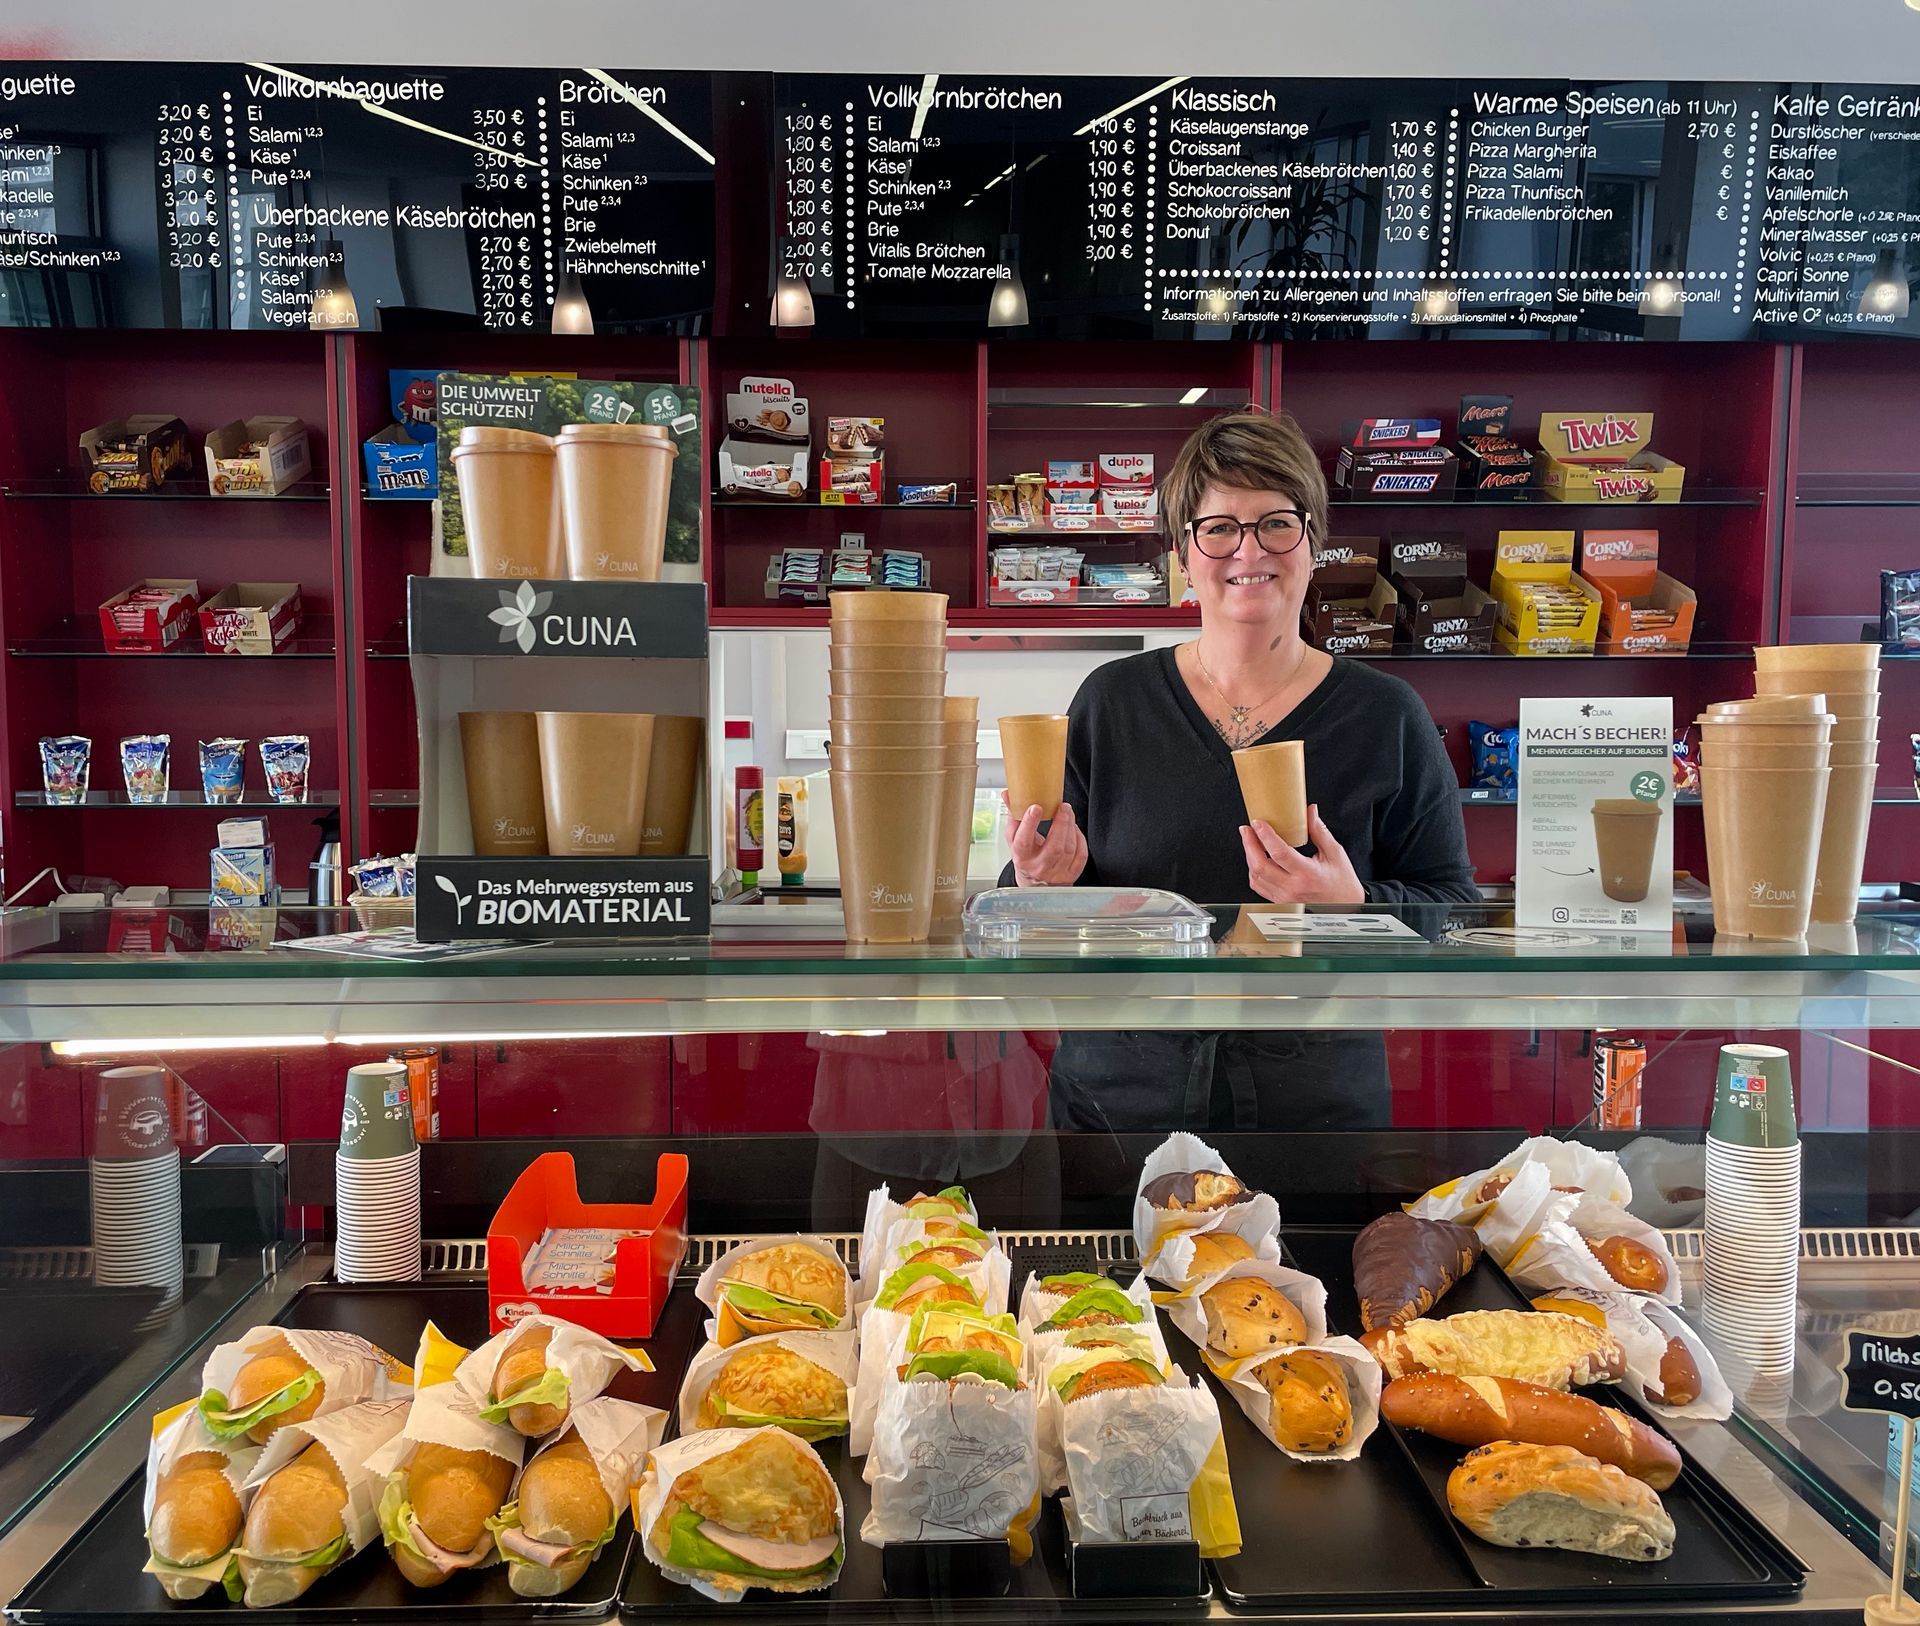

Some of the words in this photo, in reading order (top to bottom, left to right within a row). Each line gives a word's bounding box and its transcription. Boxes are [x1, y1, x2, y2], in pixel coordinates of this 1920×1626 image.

[0, 72, 75, 100] guette
[245, 74, 444, 104] Vollkornbaguette
[560, 80, 666, 103] Brötchen
[868, 85, 1062, 110] Vollkornbrötchen
[1172, 89, 1276, 112] Klassisch
[1473, 91, 1558, 113] Warme
[1565, 91, 1654, 119] Speisen
[1657, 101, 1681, 118] (ab
[1687, 102, 1700, 115] 11
[1704, 101, 1737, 118] Uhr)
[1773, 94, 1829, 116] Kalte
[158, 105, 191, 121] 3,20
[248, 106, 262, 121] Ei
[473, 110, 505, 127] 3,50
[561, 112, 575, 126] Ei
[868, 116, 881, 131] Ei
[1171, 118, 1308, 138] Käselaugenstange
[1390, 122, 1418, 138] 1,70
[1470, 121, 1531, 138] Chicken
[1536, 123, 1589, 141] Burger
[1688, 123, 1718, 139] 2,70
[1771, 124, 1865, 139] Durstlöscher
[1089, 140, 1117, 156] 1,90
[1169, 140, 1241, 156] Croissant
[1392, 143, 1417, 158] 1,40
[1469, 142, 1508, 158] Pizza
[1514, 144, 1597, 161] Margherita
[1769, 144, 1837, 159] Eiskaffee
[1168, 160, 1277, 178] Überbackenes
[1282, 162, 1388, 179] Käsebrötchen
[1389, 164, 1416, 179] 1,60
[1468, 163, 1507, 179] Pizza
[1513, 164, 1563, 179] Salami
[1767, 166, 1814, 180] Kakao
[1168, 182, 1292, 199] Schokocroissant
[1466, 185, 1505, 200] Pizza
[1510, 184, 1583, 200] Thunfisch
[1766, 185, 1848, 201] Vanillemilch
[255, 198, 389, 226] Überbackene
[397, 206, 535, 229] Käsebrötchen
[1167, 204, 1289, 219] Schokobrötchen
[1386, 206, 1413, 222] 1,20
[1465, 205, 1613, 222] Frikadellenbrötchen
[1763, 207, 1853, 224] Apfelschorle
[565, 217, 596, 232] Brie
[868, 222, 899, 237] Brie
[1167, 224, 1210, 240] Donut
[1760, 227, 1868, 241] Mineralwasser
[480, 237, 512, 253] 2,70
[565, 238, 656, 254] Zwiebelmett
[868, 243, 911, 258] Vitalis
[916, 243, 985, 258] Brötchen
[1760, 247, 1802, 261] Volvic
[1847, 253, 1876, 263] Pfand)
[785, 263, 815, 280] 2,70
[868, 264, 926, 279] Tomate
[932, 264, 1011, 280] Mozzarella
[1757, 267, 1797, 285] Capri
[1803, 267, 1849, 282] Sonne
[1163, 288, 1259, 302] Informationen
[1263, 291, 1279, 301] zu
[1284, 288, 1358, 305] Allergenen
[1362, 289, 1388, 302] und
[1393, 289, 1484, 302] Inhaltsstoffen
[1489, 289, 1551, 305] erfragen
[1557, 289, 1578, 302] Sie
[1583, 289, 1614, 302] bitte
[1617, 289, 1650, 302] beim
[1664, 290, 1720, 303] ersonal!
[1755, 288, 1839, 302] Multivitamin
[262, 308, 355, 326] Vegetarisch
[483, 312, 515, 328] 2,70
[1233, 312, 1279, 322] Farbstoffe
[1303, 312, 1399, 324] Konservierungsstoffe
[1530, 312, 1578, 324] Phosphate
[1753, 308, 1798, 322] Active
[1866, 313, 1895, 324] Pfand)
[442, 385, 467, 399] DIE
[472, 386, 541, 402] UMWELT
[744, 383, 790, 395] nutella
[592, 394, 615, 412] 2€
[651, 395, 674, 413] 5€
[762, 396, 790, 404] biscuits
[589, 408, 614, 419] PFAND
[653, 410, 677, 422] PFAND
[1462, 406, 1508, 422] Mars
[1372, 426, 1408, 438] SNICKERS
[1108, 456, 1143, 469] duplo
[743, 468, 772, 477] nutella
[1480, 472, 1531, 489] Mars
[1376, 475, 1435, 489] SNICKERS
[1393, 542, 1441, 558] CORNY
[1585, 540, 1633, 557] CORNY
[610, 561, 638, 572] CUNA
[208, 627, 239, 645] KitKat
[543, 615, 636, 646] CUNA
[1326, 635, 1369, 650] CORNY
[1425, 635, 1468, 650] CORNY
[1596, 728, 1667, 740] BECHER!
[1638, 776, 1659, 791] 2€
[1636, 788, 1657, 799] Pfand
[586, 832, 615, 844] CUNA
[478, 879, 511, 895] Das
[516, 879, 660, 900] Mehrwegsystem
[664, 881, 694, 893] aus
[1766, 889, 1796, 901] CUNA
[884, 893, 913, 904] CUNA
[477, 897, 691, 925] BIOMATERIAL
[542, 1271, 587, 1280] Schnitte
